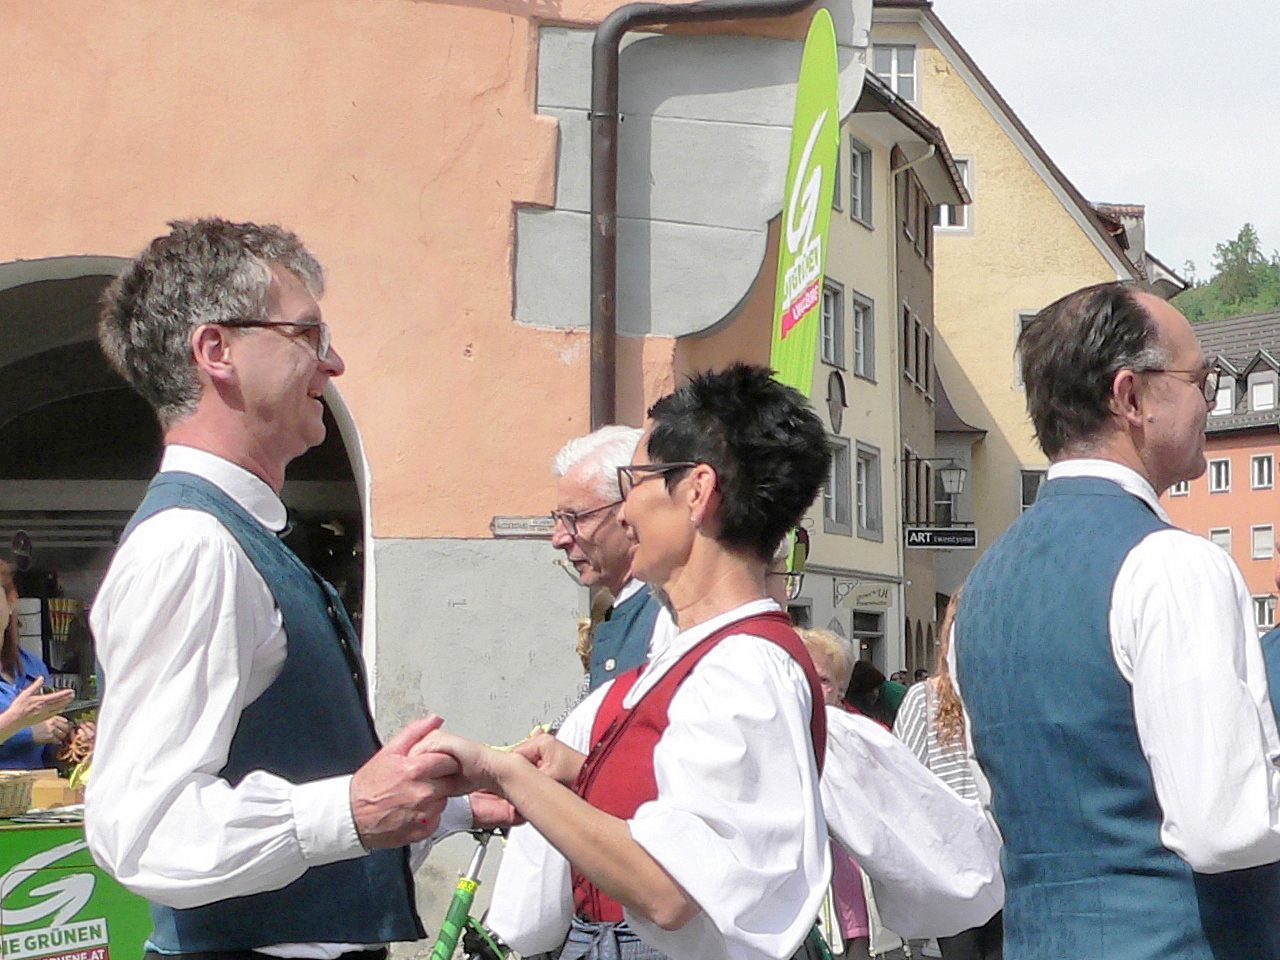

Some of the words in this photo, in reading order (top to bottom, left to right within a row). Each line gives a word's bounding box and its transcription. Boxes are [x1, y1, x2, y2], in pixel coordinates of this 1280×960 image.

[909, 531, 933, 544] ART
[0, 938, 20, 955] IE
[24, 923, 102, 951] GRÜNEN
